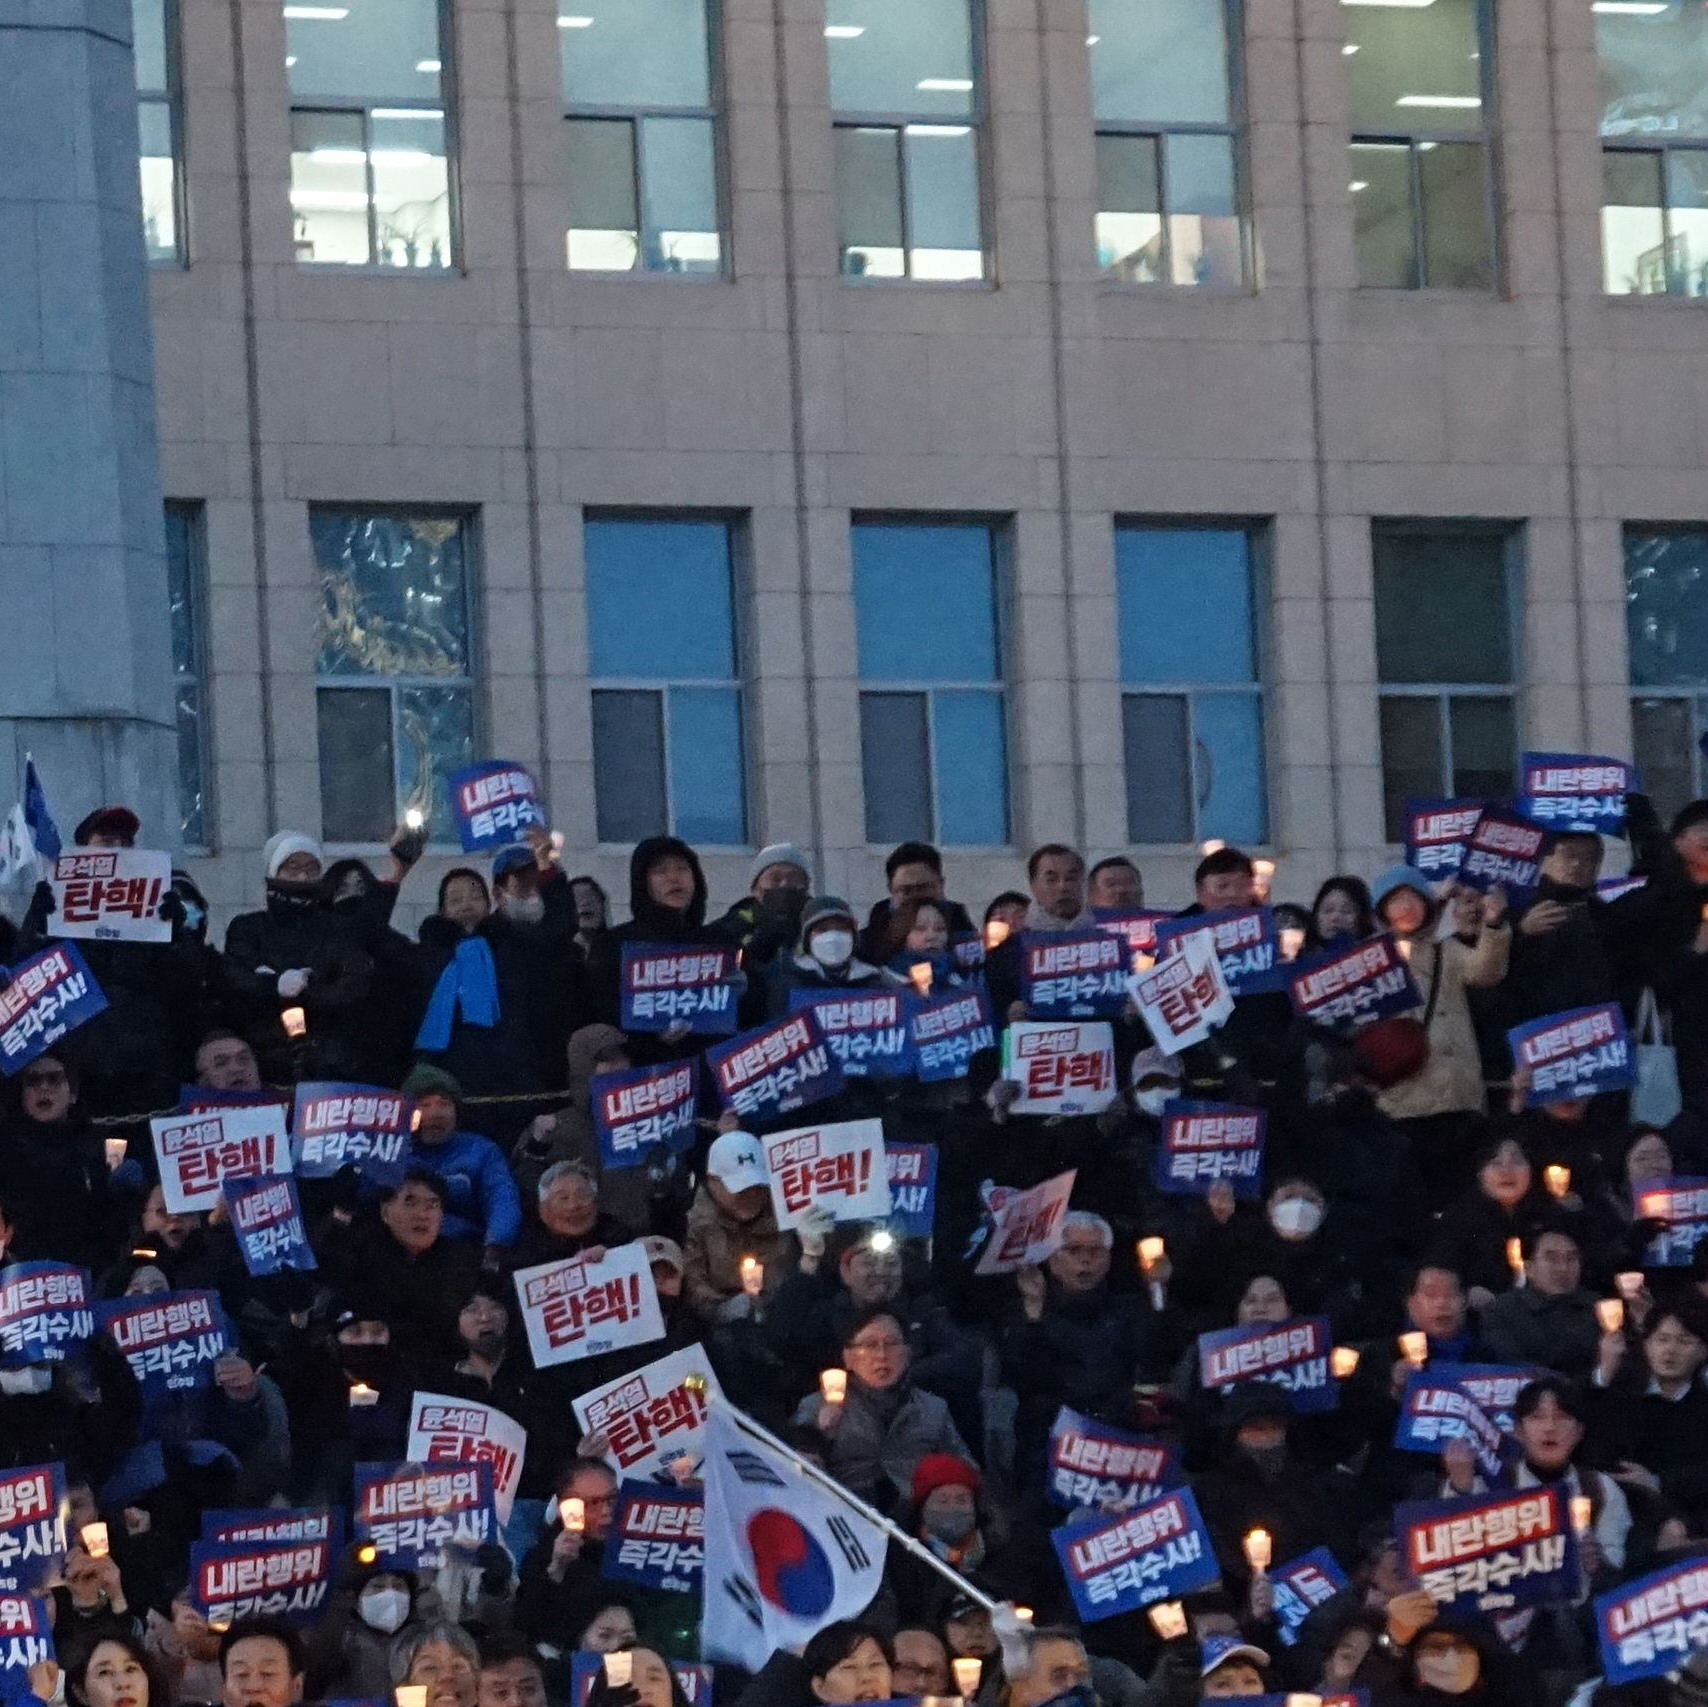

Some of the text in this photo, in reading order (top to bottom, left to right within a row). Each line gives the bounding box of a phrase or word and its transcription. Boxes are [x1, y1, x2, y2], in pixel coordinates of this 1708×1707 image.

[55, 857, 114, 879] 윤석열
[63, 876, 161, 921] 탄핵!
[634, 952, 724, 987] 내란행위
[723, 1018, 812, 1084] 내란행위
[1027, 1056, 1109, 1096] 탄핵!
[305, 1096, 401, 1132] 내란행위
[165, 1124, 224, 1152] 윤석열
[782, 1152, 871, 1212] 탄핵!
[0, 1271, 85, 1318] 내란행위
[546, 1279, 642, 1346] 탄핵!
[0, 1310, 94, 1352] 즉각수사!
[115, 1299, 212, 1346] 내란행위
[369, 1472, 479, 1516] 내란행위
[371, 1509, 488, 1553] 즉각수사!
[1074, 1503, 1185, 1576] 내란행위
[1415, 1497, 1552, 1559] 내란행위
[207, 1550, 321, 1595] 내란행위
[1084, 1537, 1203, 1605] 즉각수사!
